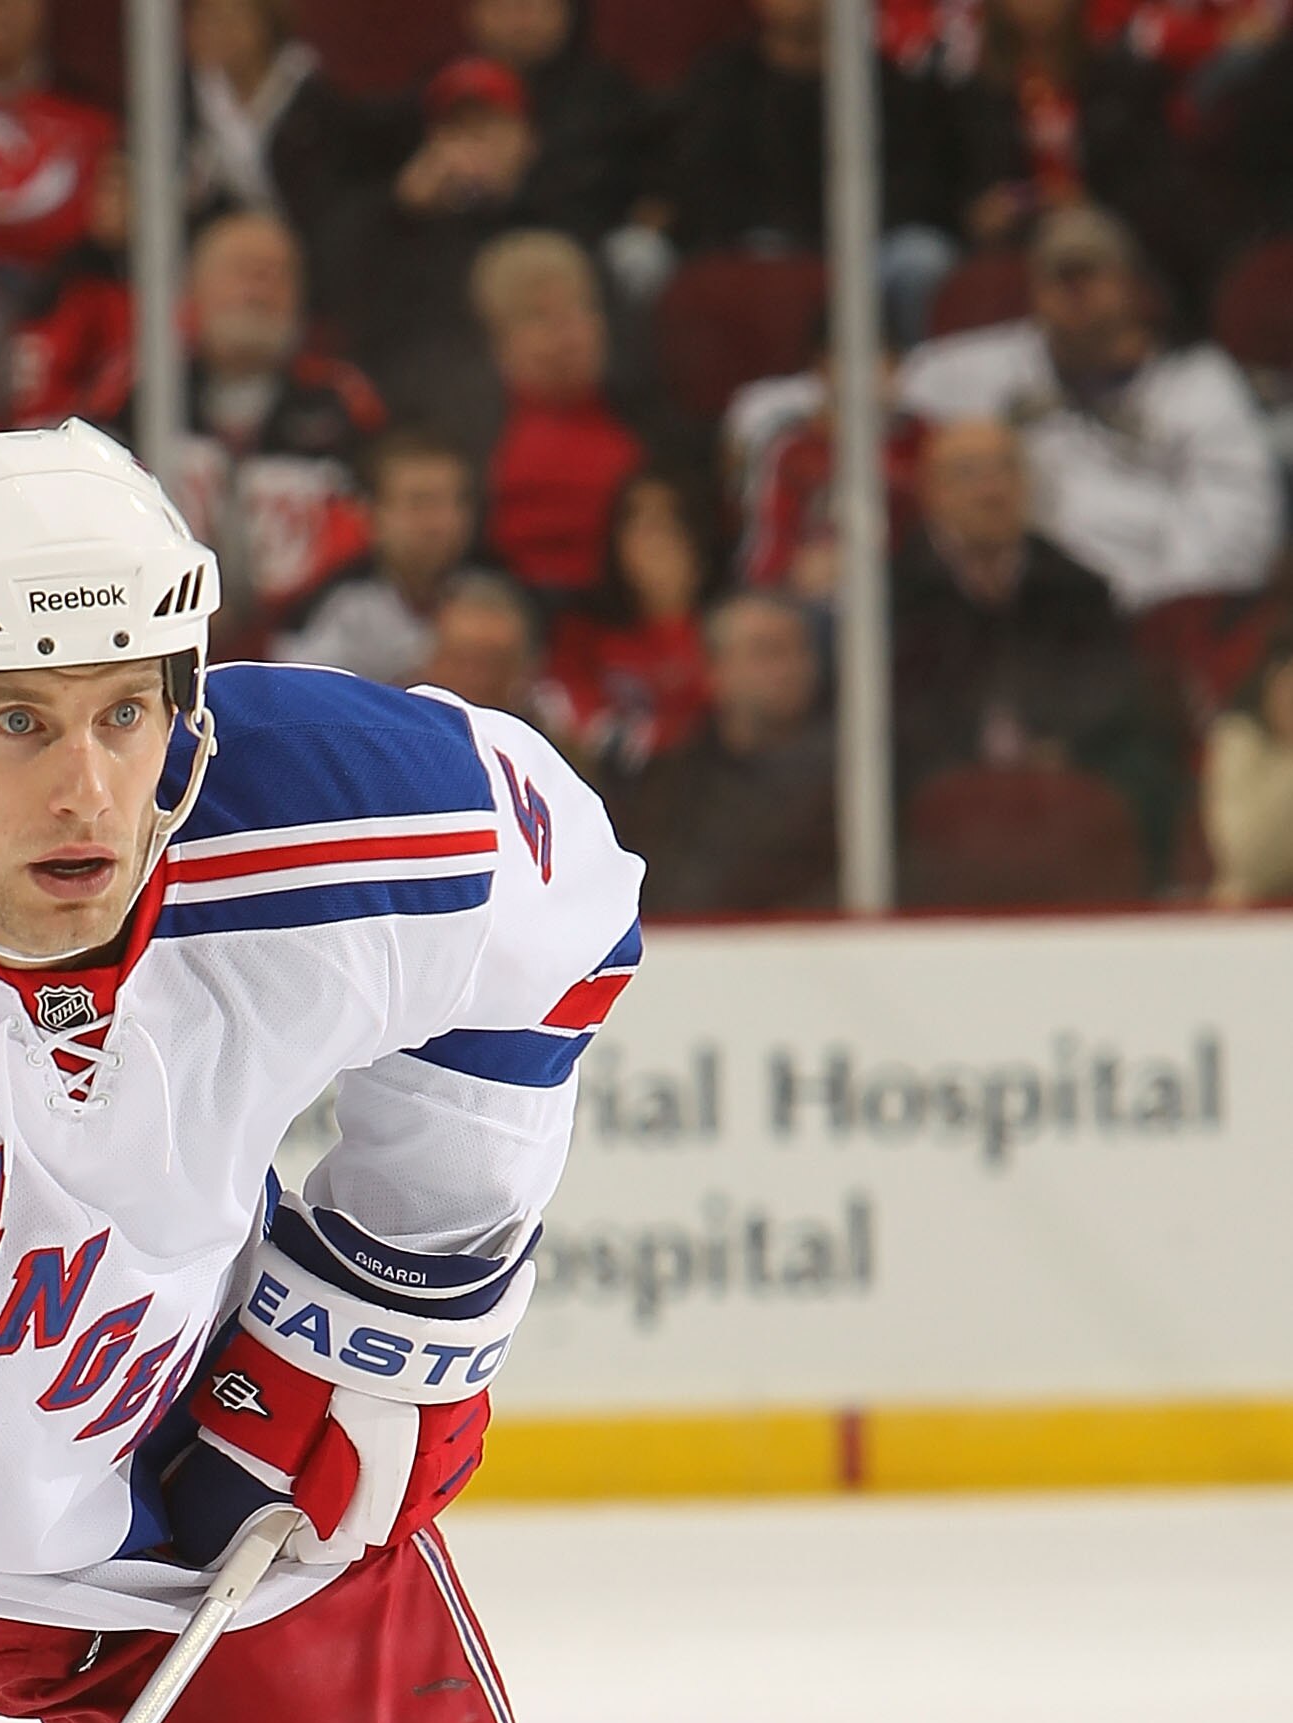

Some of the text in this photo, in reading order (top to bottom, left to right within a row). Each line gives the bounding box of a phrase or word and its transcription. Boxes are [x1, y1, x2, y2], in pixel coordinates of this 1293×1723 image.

[28, 583, 128, 614] Reebok
[51, 999, 84, 1025] NHL
[582, 1028, 1230, 1168] ial Hospital
[354, 1250, 427, 1286] GIRARDI
